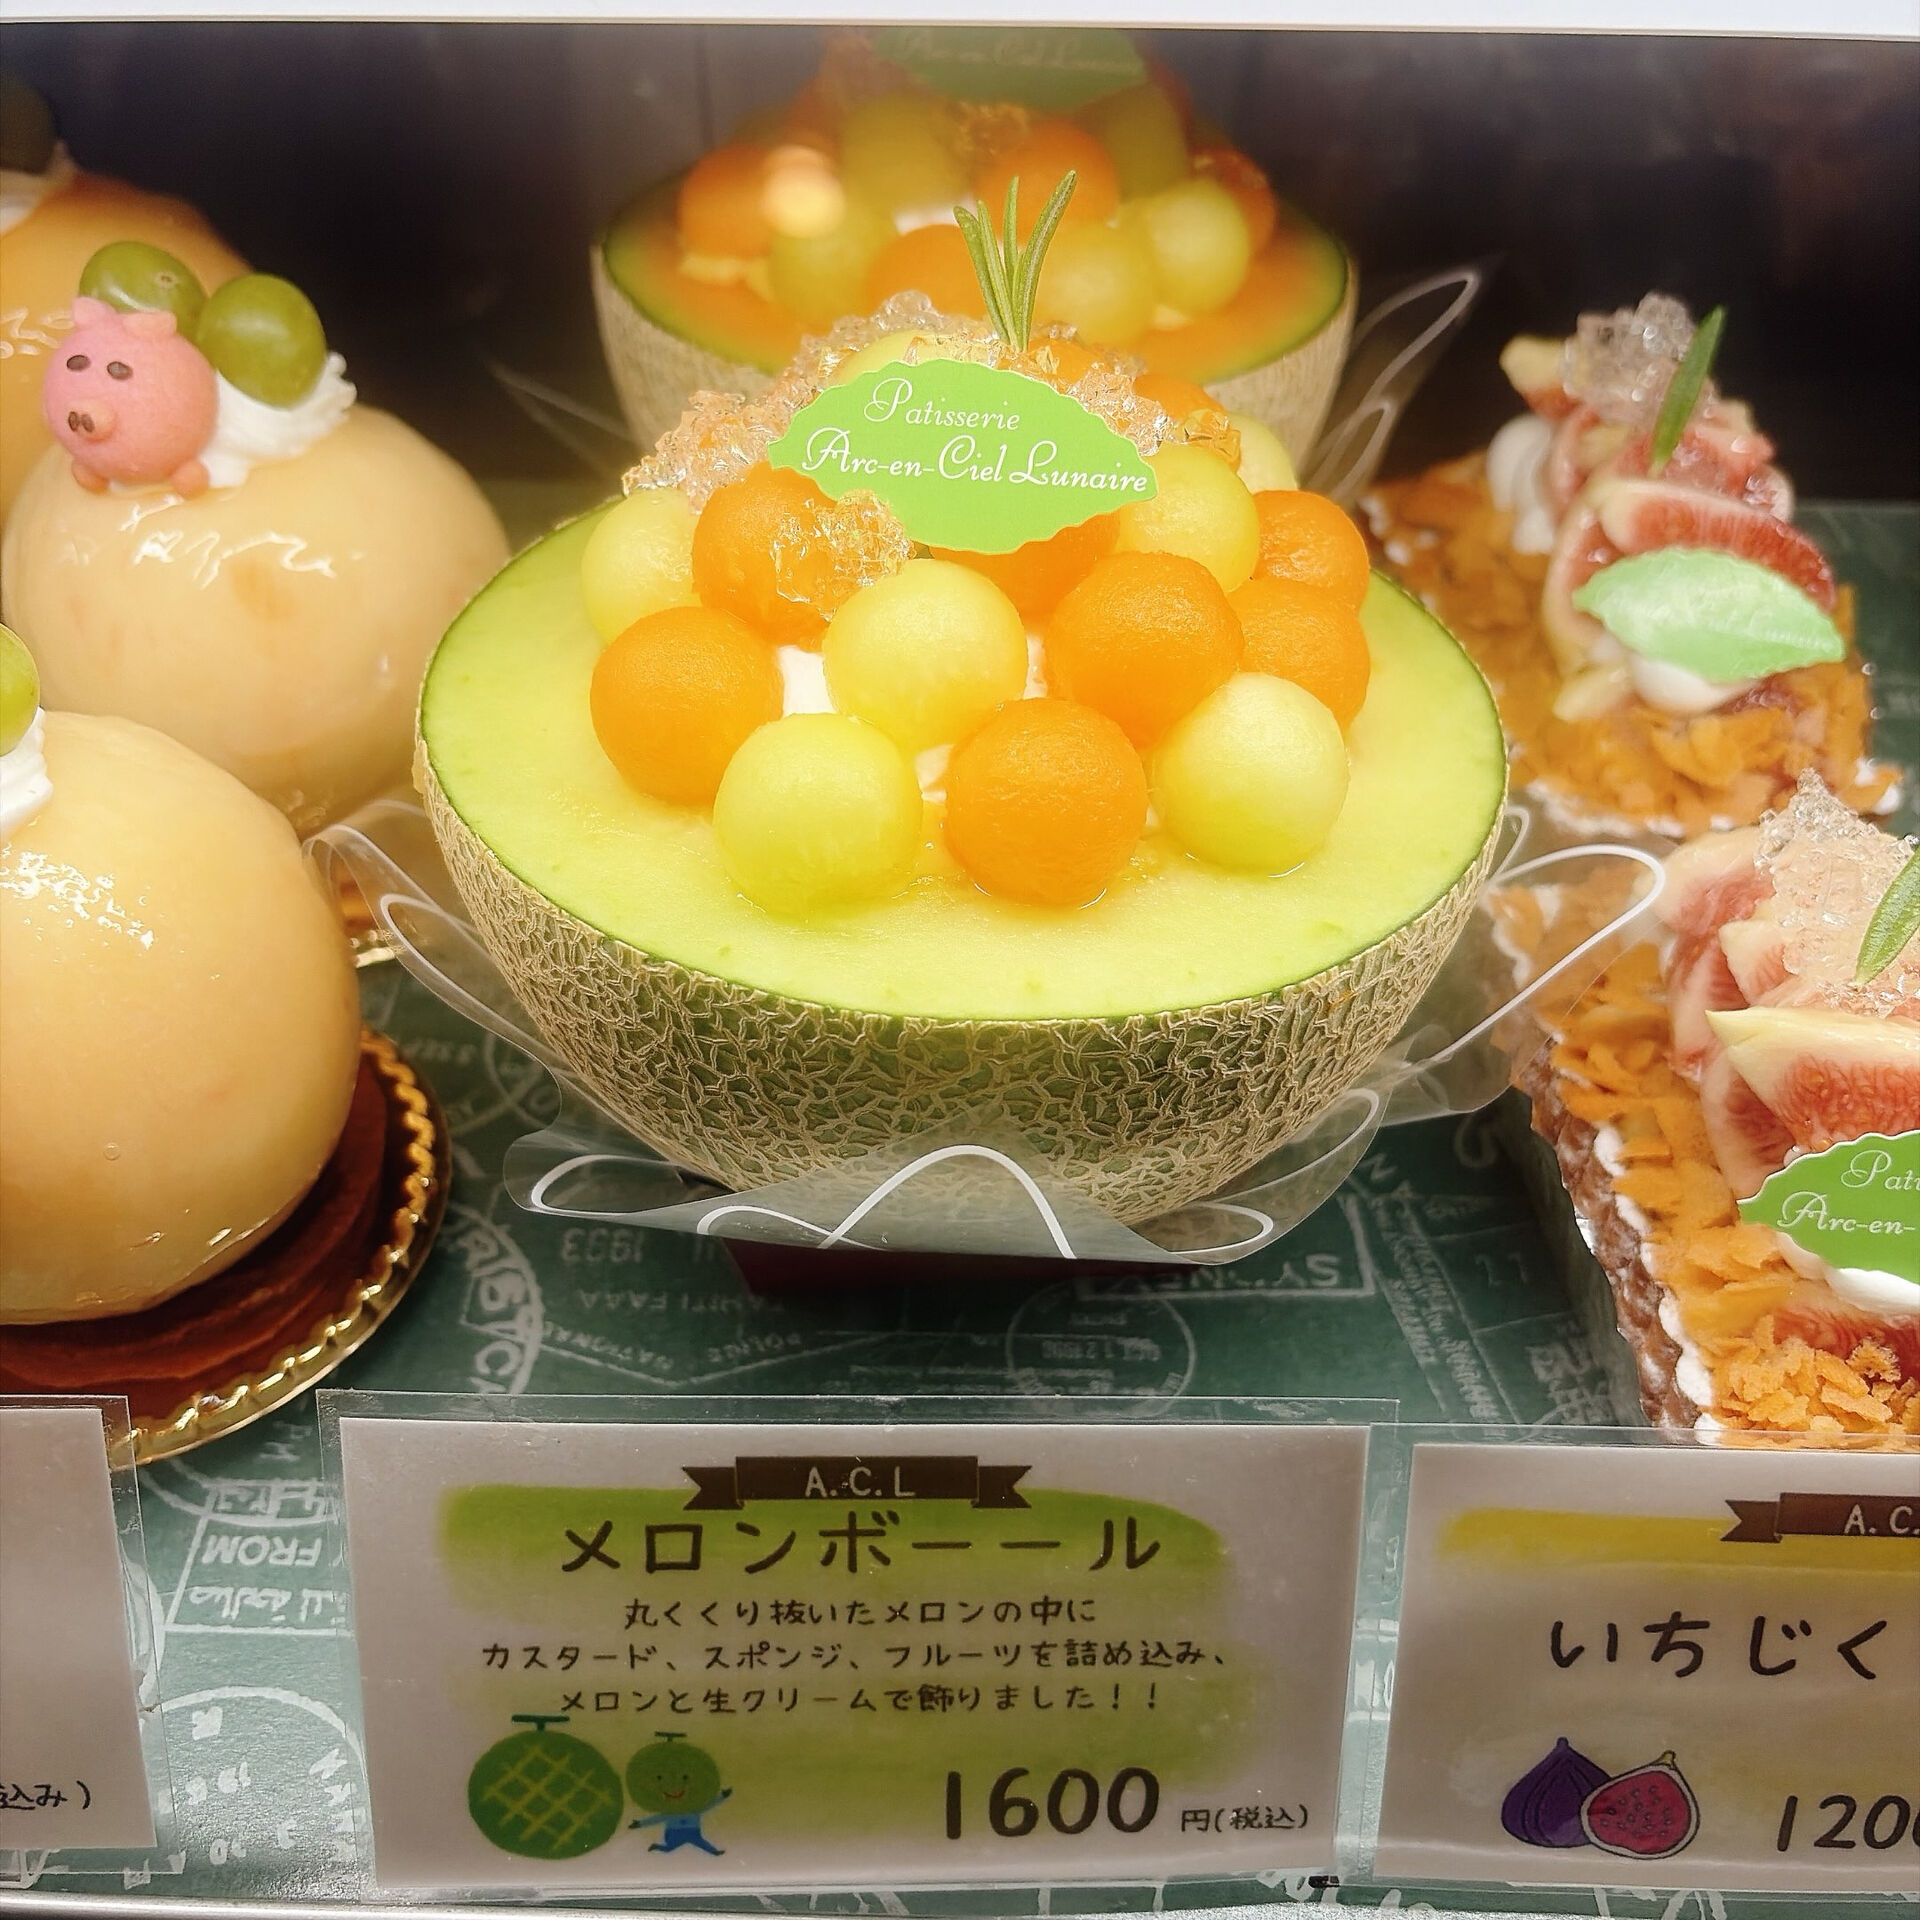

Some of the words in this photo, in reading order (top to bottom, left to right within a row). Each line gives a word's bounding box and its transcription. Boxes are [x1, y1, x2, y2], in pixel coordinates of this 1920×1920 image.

[864, 377, 1020, 431] Patisserie
[801, 426, 1007, 483] Arc-en-Ciel
[1009, 440, 1147, 492] Lunaire
[804, 1466, 915, 1498] A.C.L
[201, 1533, 323, 1567] FROM
[561, 1510, 1161, 1574] メロンボーール
[624, 1595, 1096, 1630] 丸くくり抜いたメロンの中に
[1550, 1611, 1887, 1680] いちじく
[945, 1766, 1161, 1840] 1600
[1776, 1794, 1920, 1852] 120
